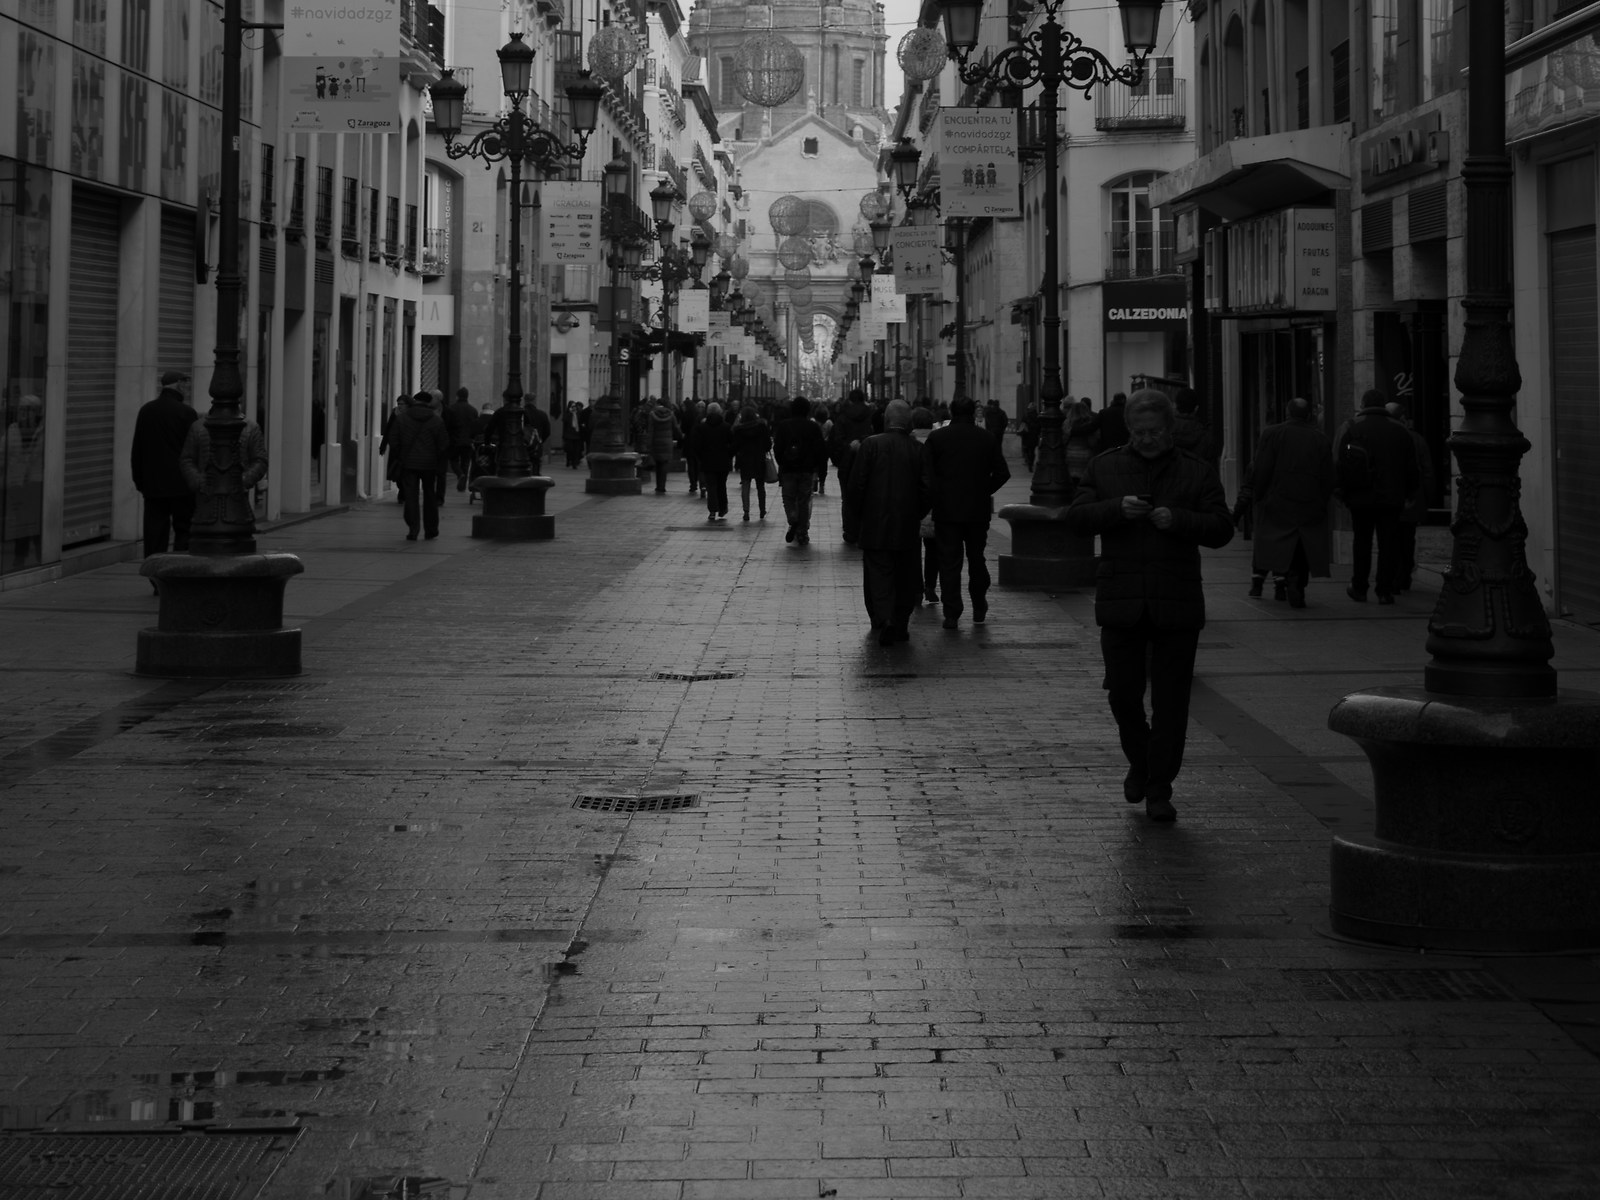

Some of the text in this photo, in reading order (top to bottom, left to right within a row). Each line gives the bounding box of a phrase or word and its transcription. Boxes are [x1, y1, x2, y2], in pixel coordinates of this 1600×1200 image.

[291, 6, 392, 23] #navidadzgz
[358, 119, 391, 129] Zaragoza
[944, 116, 1012, 125] ENCUENTRA TU
[945, 129, 1011, 141] #navidadzgz
[945, 145, 951, 153] Y
[1296, 222, 1334, 232] ADOQUINES
[896, 239, 937, 249] CONCIERTO
[1302, 248, 1330, 257] FRUTAS
[1311, 268, 1320, 276] DE
